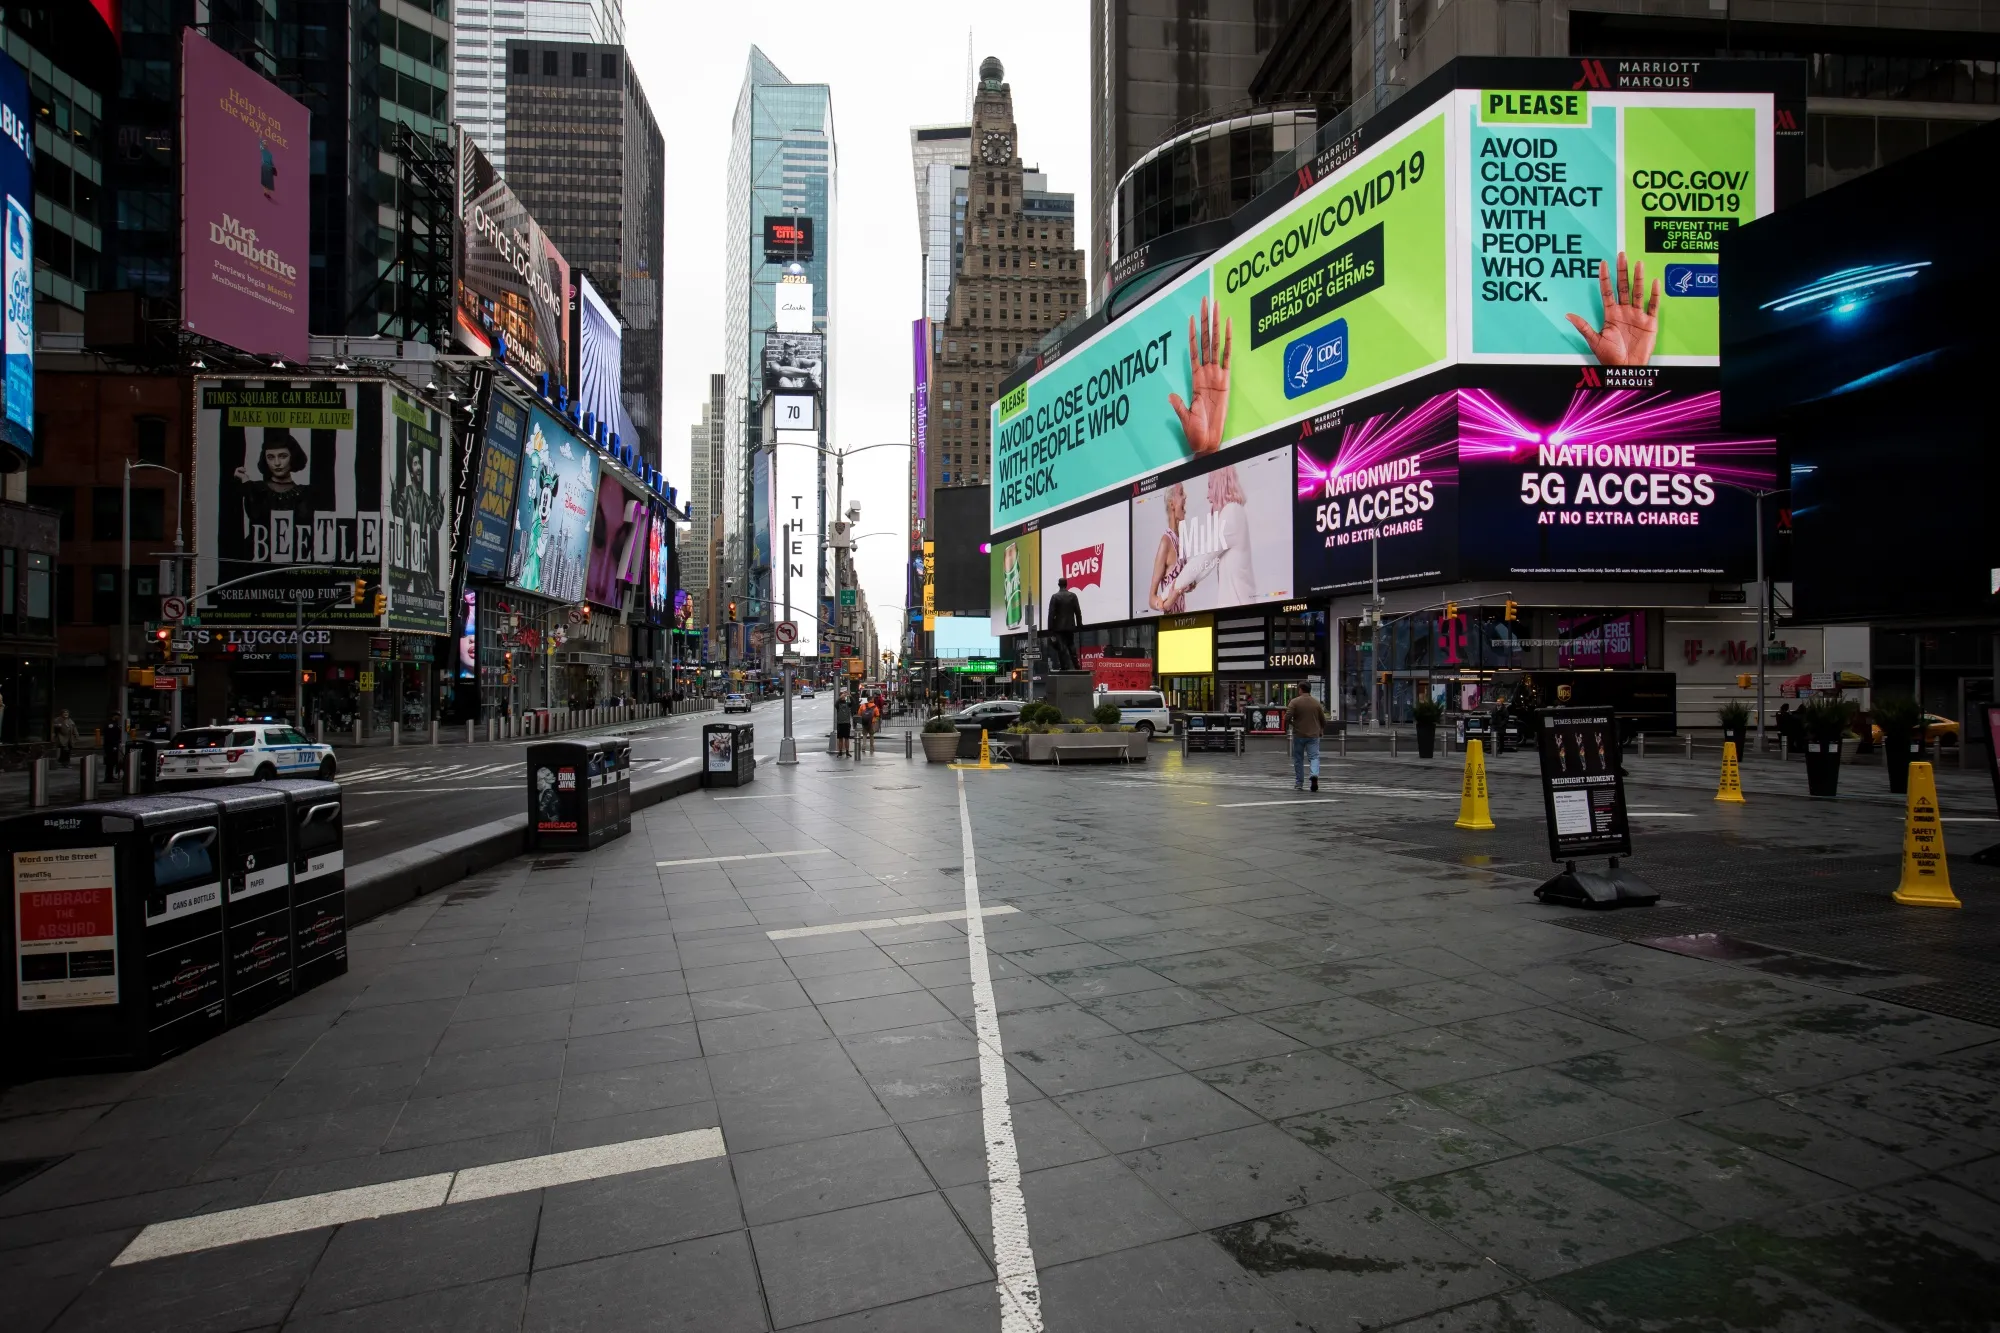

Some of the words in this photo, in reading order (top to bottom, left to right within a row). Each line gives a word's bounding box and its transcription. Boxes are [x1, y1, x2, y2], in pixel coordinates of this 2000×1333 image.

[1619, 62, 1701, 74] MARRIOTT
[1619, 76, 1690, 88] MARQUIS
[229, 88, 256, 114] Help
[258, 107, 267, 122] is
[268, 117, 281, 131] on
[1489, 94, 1579, 116] PLEASE
[220, 98, 238, 118] the
[240, 112, 263, 138] way,
[264, 127, 289, 150] dear.
[1317, 127, 1364, 166] MARRIOTT
[1479, 138, 1558, 159] AVOID
[1317, 144, 1358, 179] MARQUIS
[1480, 162, 1567, 183] CLOSE
[1632, 170, 1749, 191] CDC.GOV/
[1481, 186, 1603, 207] CONTACT
[1641, 192, 1741, 213] COVID19
[222, 213, 260, 242] Mrs.
[1226, 150, 1425, 294] CDC.GOV/COVID19
[1481, 210, 1545, 230] WITH
[1653, 222, 1705, 231] PREVENT
[1707, 222, 1729, 231] THE
[475, 205, 511, 263] OFFICE
[513, 228, 530, 257] PRIME
[1482, 234, 1583, 255] PEOPLE
[1667, 231, 1712, 241] SPREAD
[209, 221, 297, 280] Doubtfire
[1662, 241, 1679, 250] OF
[1680, 241, 1719, 250] GERMS
[1114, 245, 1150, 273] MARRIOTT
[1481, 257, 1545, 278] WHO
[1550, 258, 1602, 279] ARE
[214, 259, 245, 280] Previews
[247, 273, 266, 289] begin
[267, 284, 288, 299] March
[783, 275, 807, 283] 2020
[1114, 259, 1145, 283] MARQUIS
[1271, 268, 1324, 311] PREVENT
[1327, 252, 1354, 281] THE
[1697, 274, 1717, 285] CDC
[513, 247, 561, 318] LOCATIONS
[1482, 281, 1548, 303] SICK.
[1258, 297, 1304, 335] SPREAD
[1306, 289, 1323, 310] OF
[1326, 260, 1375, 297] GERMS
[1318, 340, 1341, 364] CDC
[1606, 369, 1660, 377] MARRIOTT
[1606, 378, 1654, 387] MARQUIS
[207, 391, 237, 405] TIMES
[240, 391, 279, 406] SQUARE
[282, 391, 302, 405] CAN
[305, 391, 342, 405] REALLY
[540, 372, 595, 435] 1540
[999, 415, 1034, 456] AVOID
[1037, 384, 1083, 434] CLOSE
[1086, 330, 1172, 407] CONTACT
[1001, 387, 1026, 417] PLEASE
[232, 410, 262, 424] MAKE
[266, 411, 286, 424] YOU
[290, 411, 314, 424] FEEL
[318, 411, 351, 426] ALIVE!
[787, 406, 800, 419] 70
[1315, 407, 1344, 425] MARRIOTT
[1315, 416, 1342, 432] MARQUIS
[999, 444, 1028, 483] WITH
[1031, 416, 1084, 465] PEOPLE
[1088, 394, 1130, 440] WHO
[459, 433, 475, 490] MAC
[487, 447, 516, 478] COME
[602, 421, 677, 505] BROADWAY
[1538, 445, 1696, 468] NATIONWIDE
[1141, 476, 1159, 487] MARRIOTT
[1325, 455, 1421, 498] NATIONWIDE
[999, 479, 1022, 512] ARE
[1025, 463, 1058, 501] SICK.
[1141, 483, 1157, 493] MARQUIS
[1521, 473, 1565, 505] 5G
[1574, 473, 1715, 506] ACCESS
[479, 491, 510, 519] AWAY
[1316, 505, 1341, 532] 5G
[1346, 479, 1435, 528] ACCESS
[451, 496, 465, 552] MAC
[1538, 511, 1556, 525] AT
[1559, 511, 1581, 525] NO
[1584, 511, 1634, 525] EXTRA
[1637, 511, 1699, 525] CHARGE
[252, 517, 377, 564] BEETLE
[791, 496, 803, 578] THEN
[1325, 536, 1336, 548] AT
[1338, 533, 1350, 546] NO
[1352, 525, 1382, 543] EXTRA
[1383, 519, 1424, 538] CHARGE
[1282, 603, 1308, 612] SEPHORA
[227, 630, 331, 644] LUGGAGE
[238, 644, 256, 652] NY
[1269, 653, 1315, 667] SEPHORA
[1558, 689, 1571, 700] ups
[298, 751, 316, 763] NYPD
[558, 772, 576, 781] ERIKA
[558, 781, 576, 789] JAYNE
[1551, 776, 1585, 785] MIDNIGHT
[1586, 775, 1615, 784] MOMENT
[44, 818, 82, 827] BigBelly
[537, 821, 577, 829] CHICAGO
[312, 863, 324, 871] TRASH
[250, 878, 265, 888] PAPER
[32, 890, 101, 908] EMBRACE
[172, 900, 188, 910] CANS
[193, 892, 216, 904] BOTTLES
[55, 908, 76, 919] THE
[38, 921, 96, 939] ABSURD
